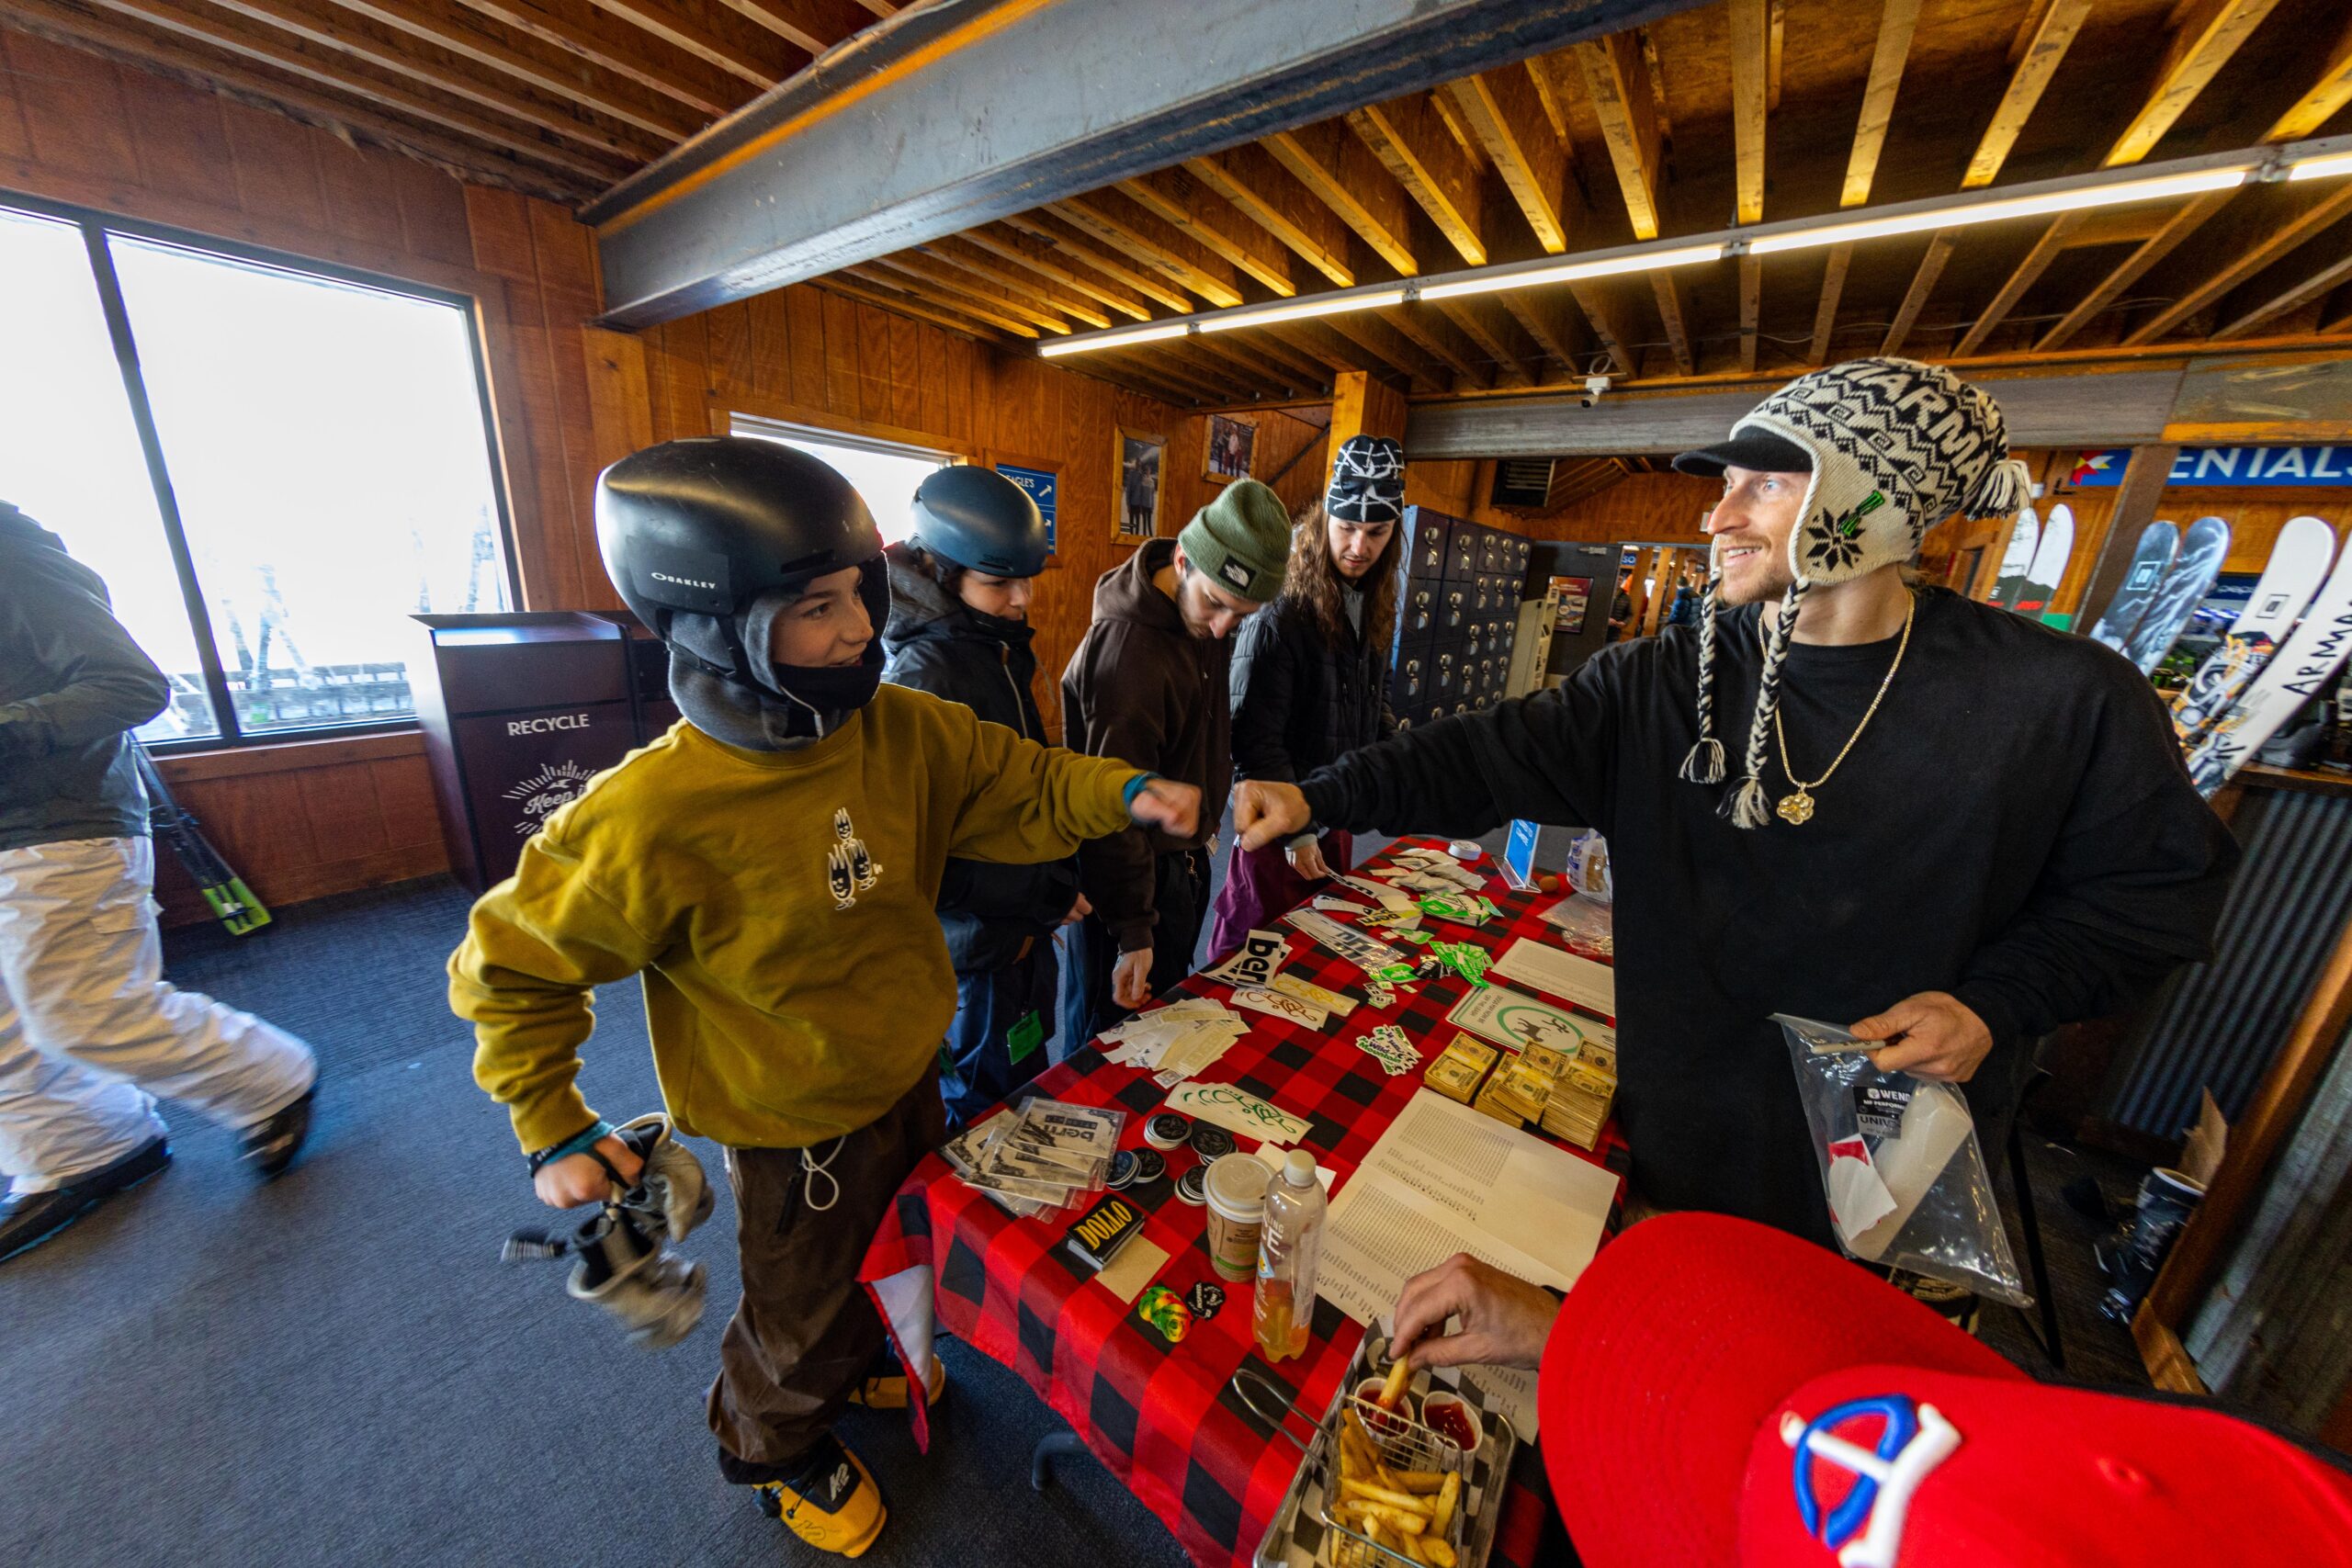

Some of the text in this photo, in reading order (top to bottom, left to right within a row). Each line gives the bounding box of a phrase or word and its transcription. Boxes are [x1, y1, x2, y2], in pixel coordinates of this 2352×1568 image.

[667, 575, 717, 590] OAKLEY
[2281, 600, 2352, 696] ARMA
[506, 714, 590, 736] RECYCLE
[523, 790, 576, 815] Keep
